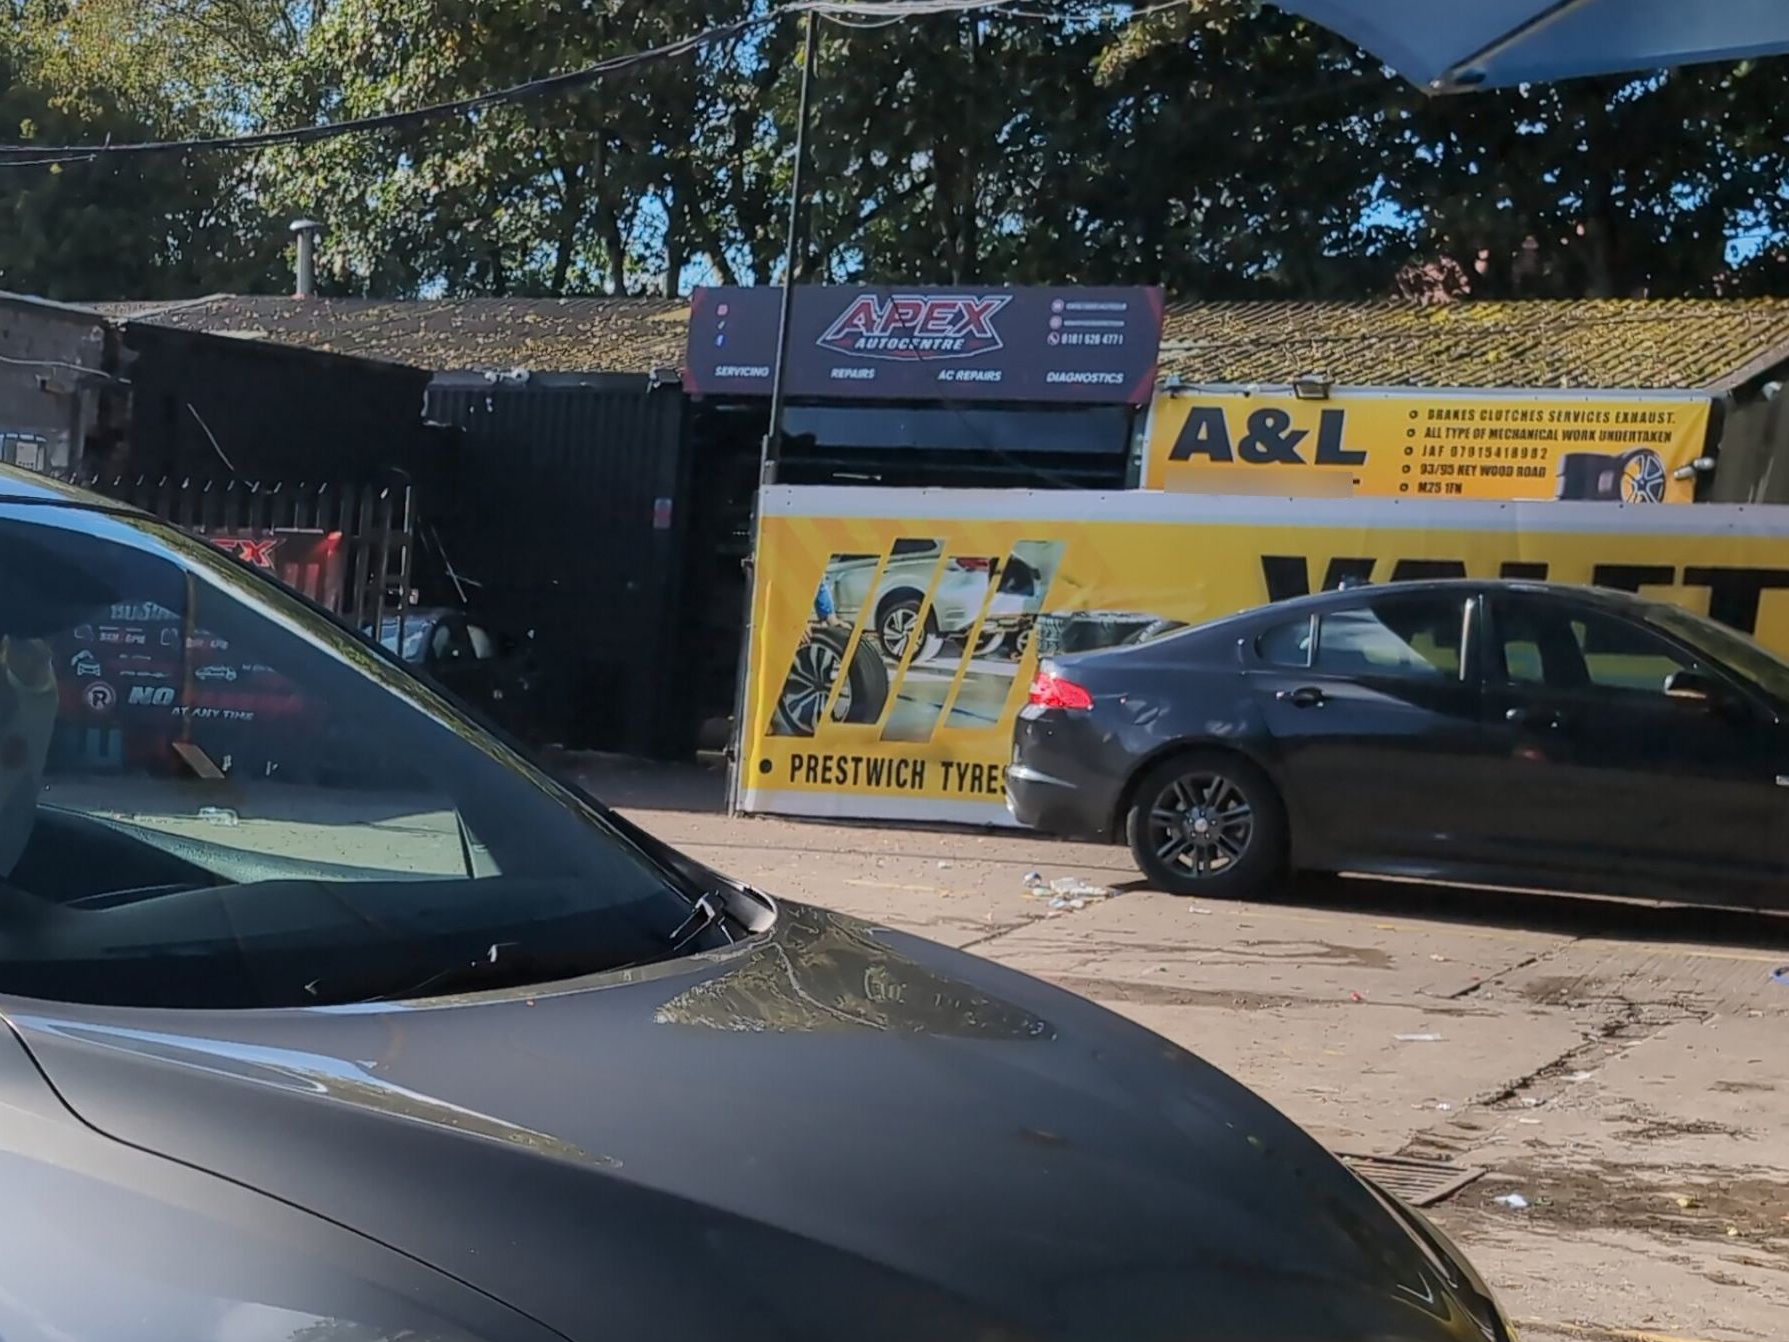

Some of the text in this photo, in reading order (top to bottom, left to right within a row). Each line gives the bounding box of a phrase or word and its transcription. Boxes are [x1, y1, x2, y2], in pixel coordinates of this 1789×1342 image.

[825, 297, 1003, 340] APEX
[854, 336, 965, 350] AUTOCENTRE
[715, 366, 770, 377] SERVICING
[830, 367, 876, 379] REPAIRS
[938, 369, 1002, 381] AC REPAIRS
[1046, 371, 1124, 384] DIAGNOSTICS
[1427, 408, 1475, 421] BRAKES
[1479, 409, 1544, 422] CLUTCHES
[1548, 410, 1610, 423] SERVICES
[1168, 406, 1368, 465] A&L
[1424, 427, 1673, 443] ALL TYPE OF MECHANICAL WORK UNDERTAKEN
[1516, 466, 1547, 478] ROAD
[129, 686, 175, 705] NO
[789, 753, 926, 790] PRESTWICH
